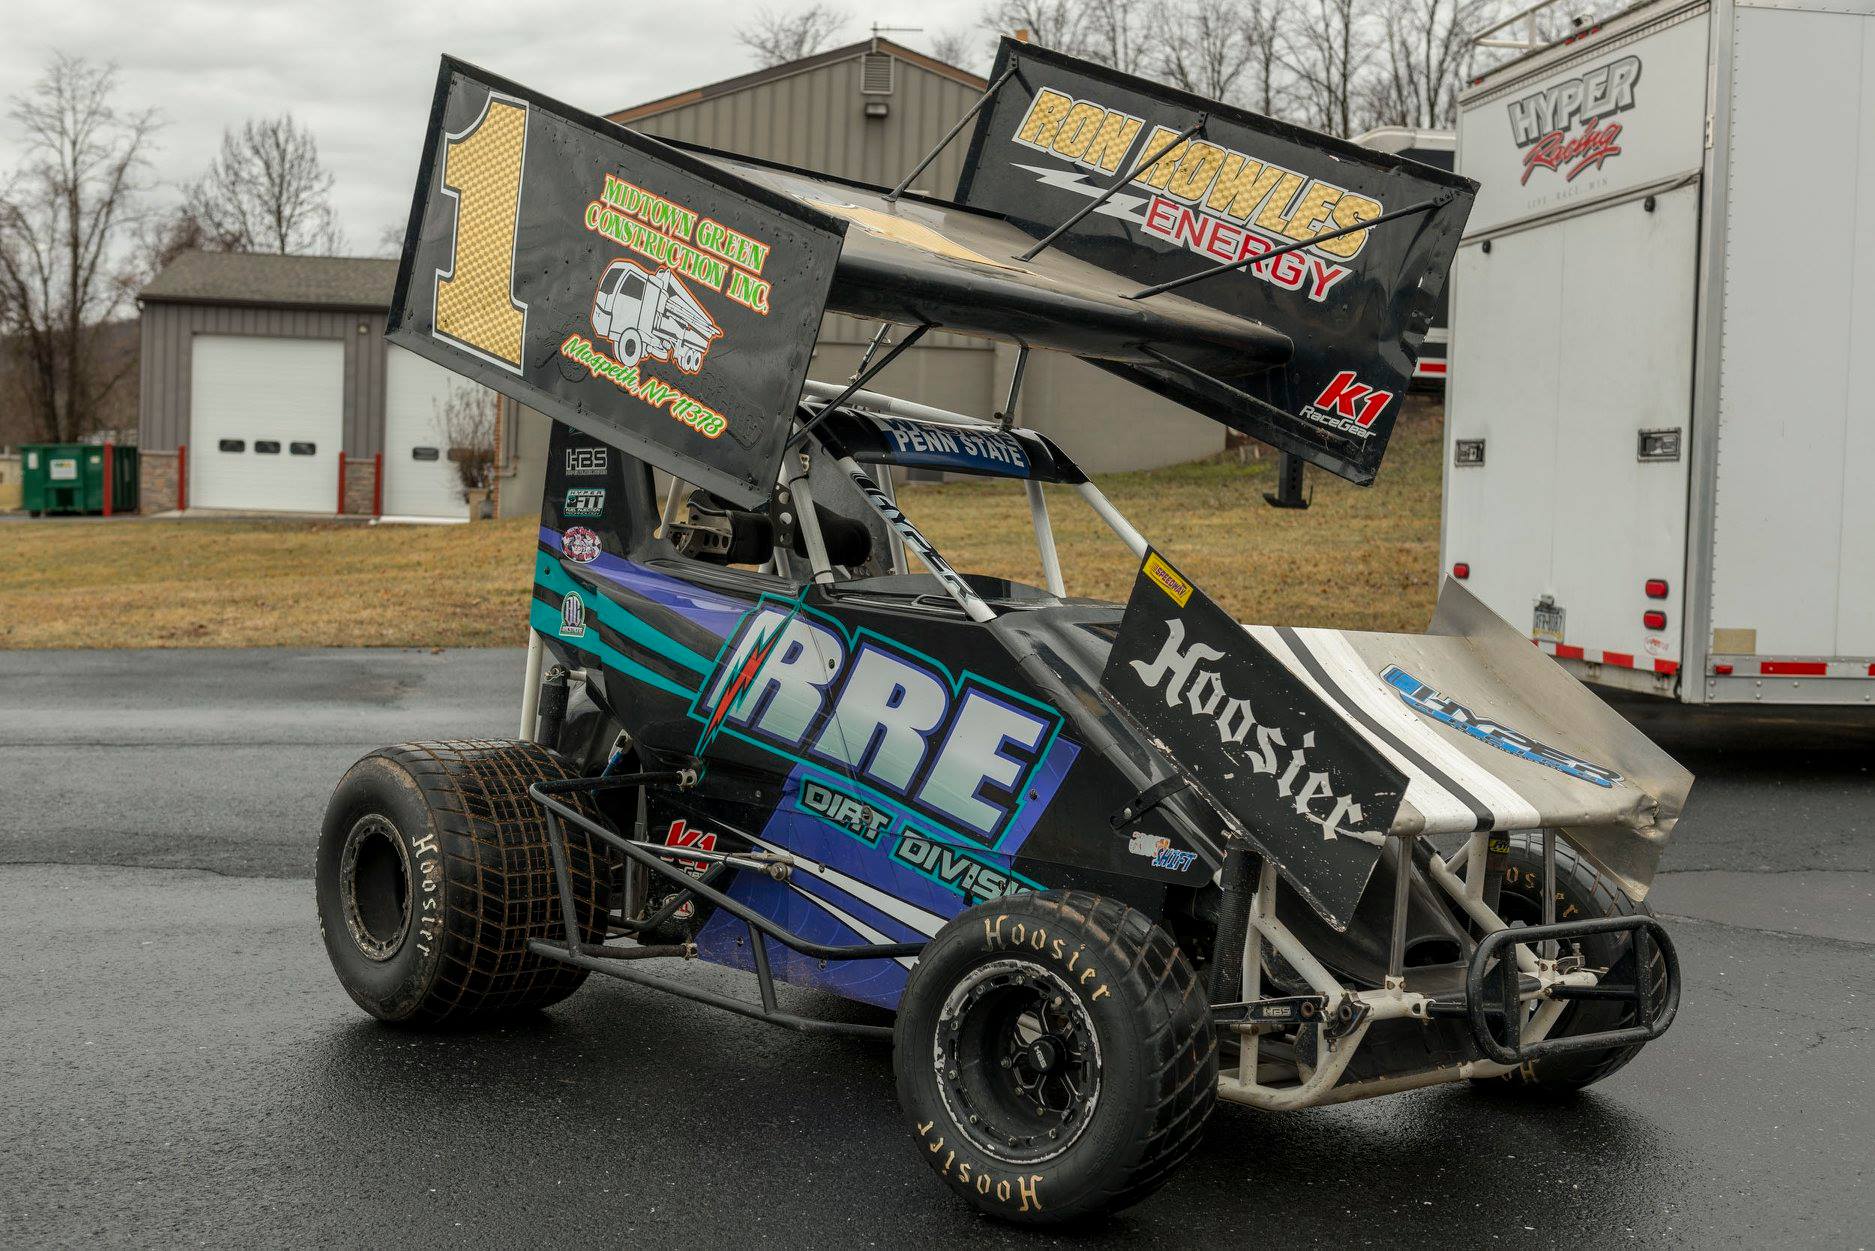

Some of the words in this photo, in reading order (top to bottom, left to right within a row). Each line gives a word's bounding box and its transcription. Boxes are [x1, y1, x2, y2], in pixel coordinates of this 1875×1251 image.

[1507, 55, 1642, 148] HYPER
[1012, 87, 1146, 176] RON
[1125, 125, 1383, 262] ROWLES
[1520, 117, 1622, 186] Racing
[432, 91, 529, 376] 1
[585, 202, 729, 292] CONSTRUCTION
[729, 267, 771, 315] INC.
[600, 175, 698, 241] MIDTOWN
[697, 217, 771, 273] GREEN
[1141, 195, 1352, 302] ENERGY
[561, 335, 641, 395] Maspeth,
[639, 378, 681, 406] NY
[671, 396, 727, 437] 11378
[1299, 405, 1376, 438] RaceGear
[1313, 371, 1393, 428] K1
[566, 448, 607, 470] HBS
[893, 428, 959, 453] PENN
[960, 433, 1025, 467] STATE
[1153, 563, 1188, 598] SPEEDWAY
[706, 606, 1049, 838] RRE
[1129, 618, 1364, 840] Hoosier
[804, 783, 888, 840] DIRT
[412, 834, 442, 957] Hoosier
[1152, 848, 1198, 872] SHIFT
[981, 914, 1111, 1000] Hoosier
[917, 1120, 1043, 1211] Hoosier
